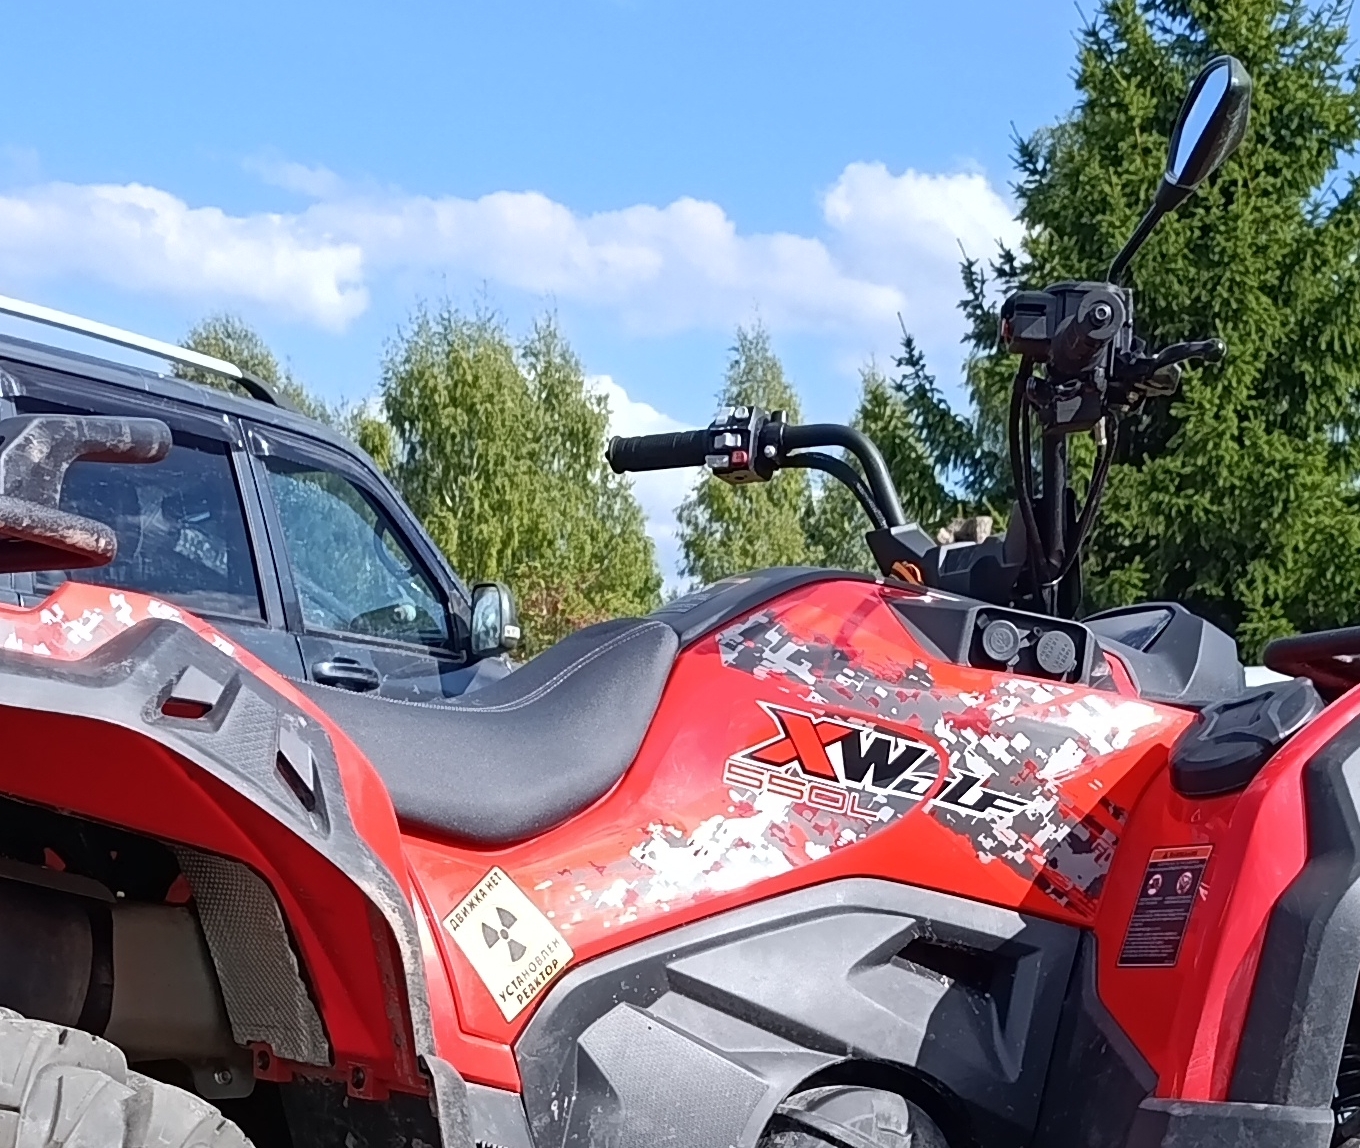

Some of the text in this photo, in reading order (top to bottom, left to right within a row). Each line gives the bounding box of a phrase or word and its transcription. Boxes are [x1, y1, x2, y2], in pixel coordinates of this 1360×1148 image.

[449, 871, 503, 931] ДВИЖКА НЕТ
[499, 938, 560, 1002] УСТАНОВЛЕН
[516, 958, 559, 1005] РЕАКТОР
